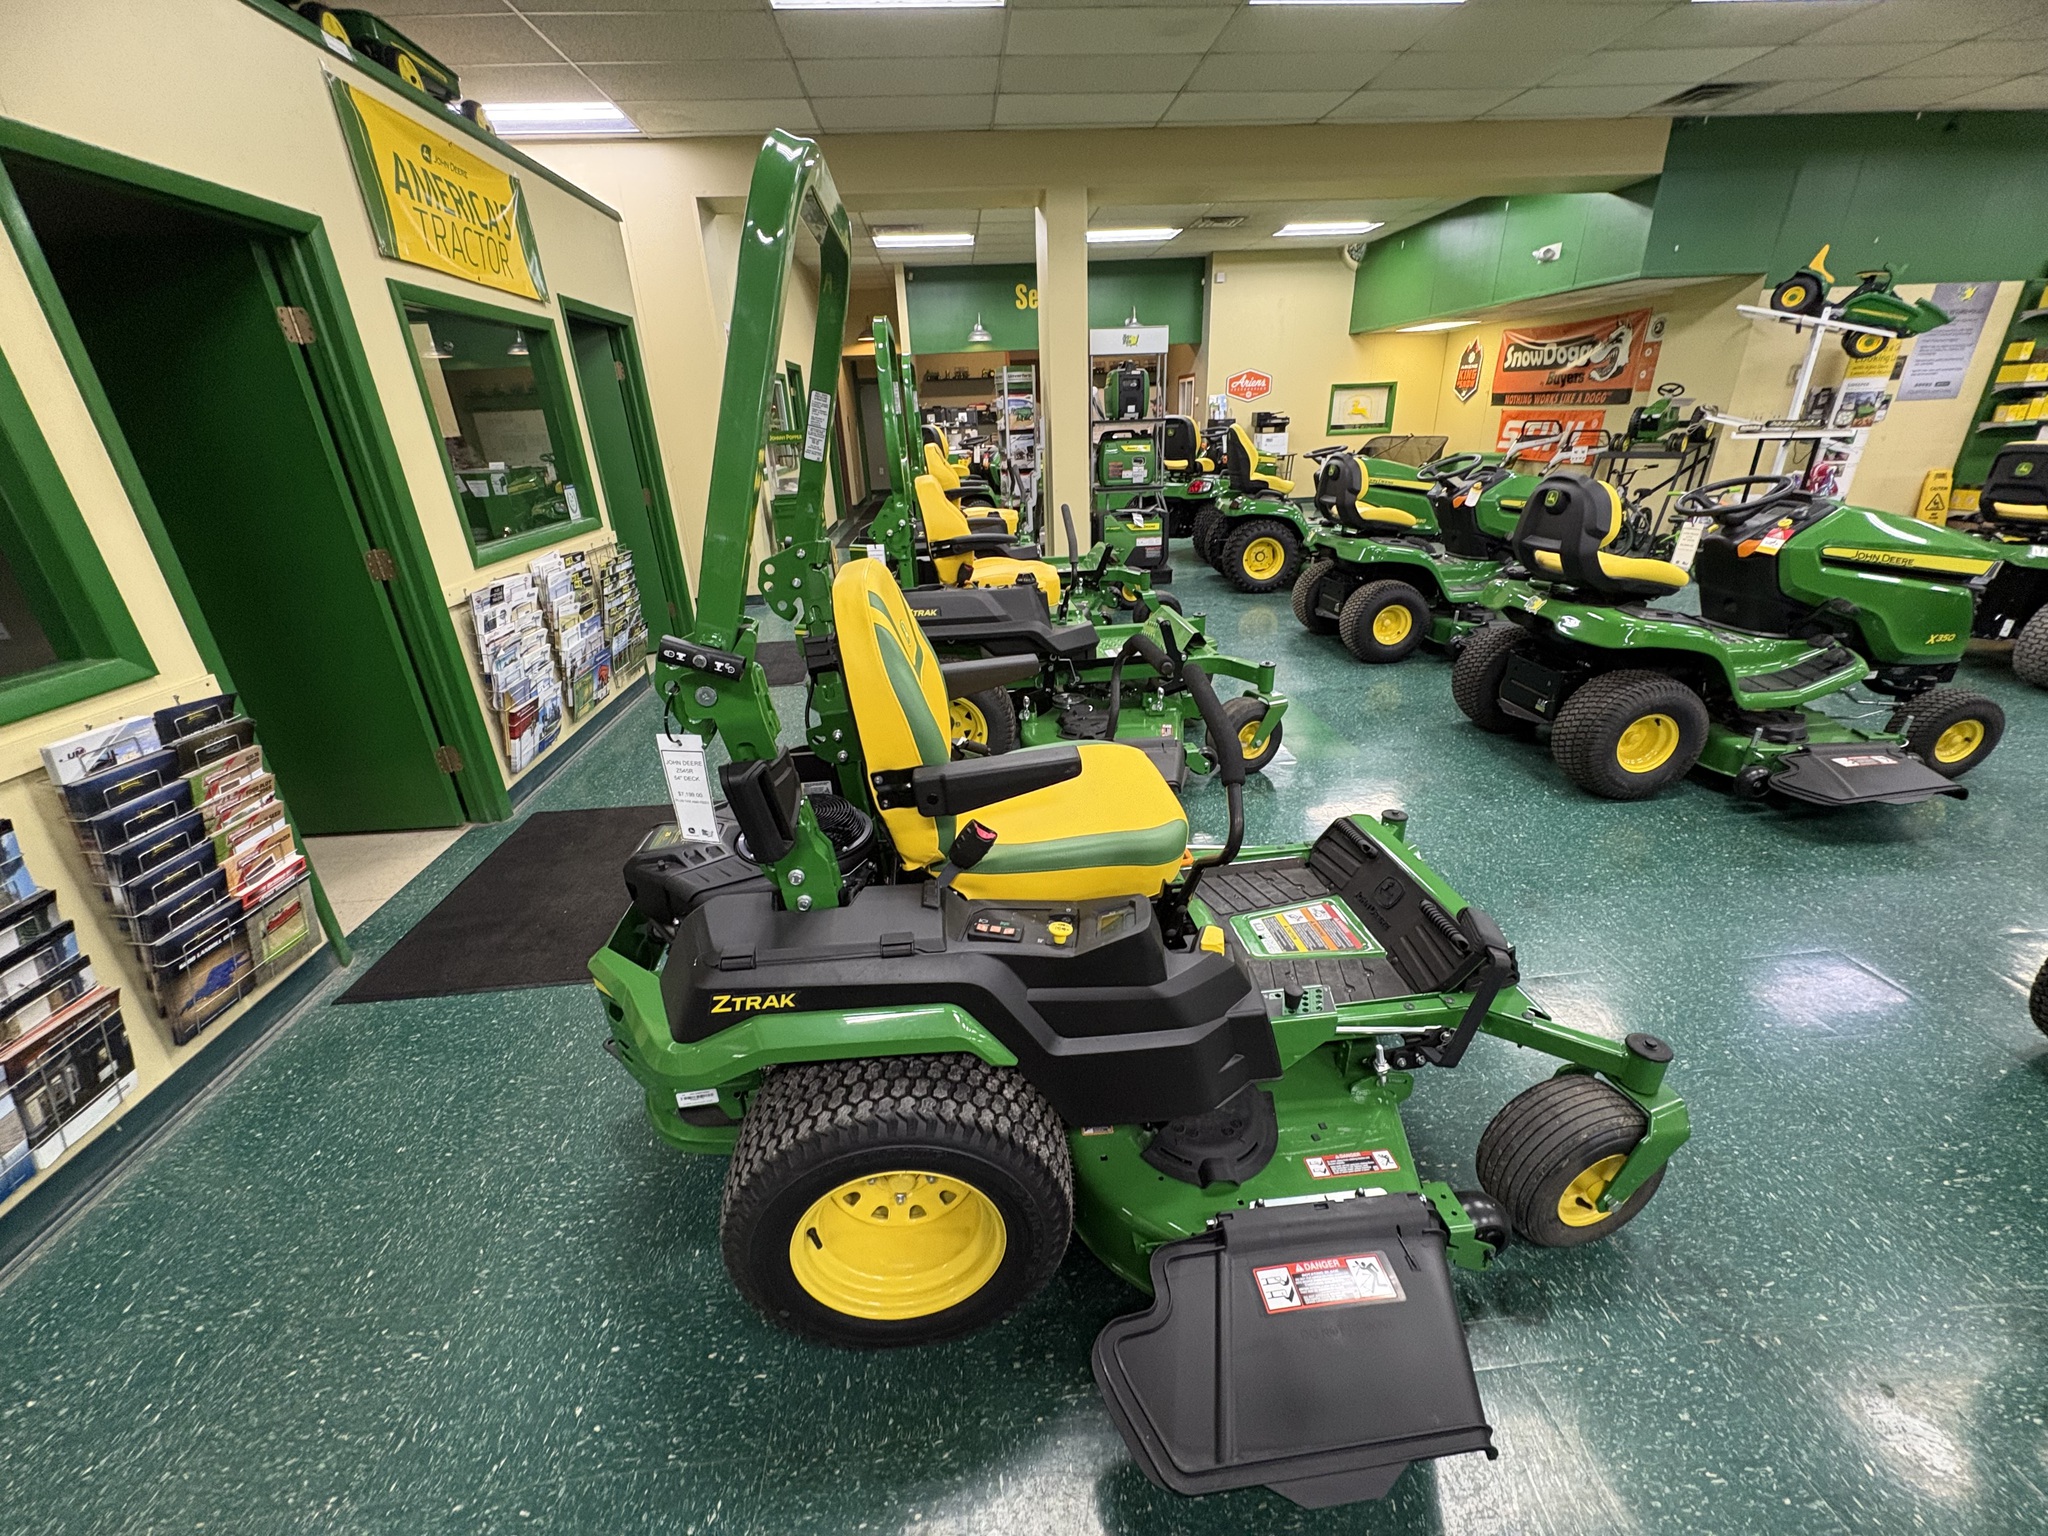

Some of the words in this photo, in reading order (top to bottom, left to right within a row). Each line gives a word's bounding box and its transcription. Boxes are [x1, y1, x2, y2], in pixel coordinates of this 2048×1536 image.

[434, 156, 450, 170] JOHN
[450, 163, 468, 179] DEERE
[393, 152, 512, 241] AMERICA'S
[413, 206, 514, 279] TRACTOR
[1231, 374, 1266, 388] Ariens
[1457, 369, 1477, 380] KING
[1545, 372, 1585, 387] Buyers
[1504, 394, 1532, 405] NOTHING
[1534, 393, 1559, 404] WORKS
[1560, 392, 1576, 403] LIKE
[1577, 393, 1584, 403] A
[1851, 549, 1882, 564] JOHN
[1881, 554, 1915, 566] DEERE
[1925, 633, 1956, 645] X350
[711, 993, 796, 1014] ZTRAK
[1304, 1258, 1341, 1272] DANGER
